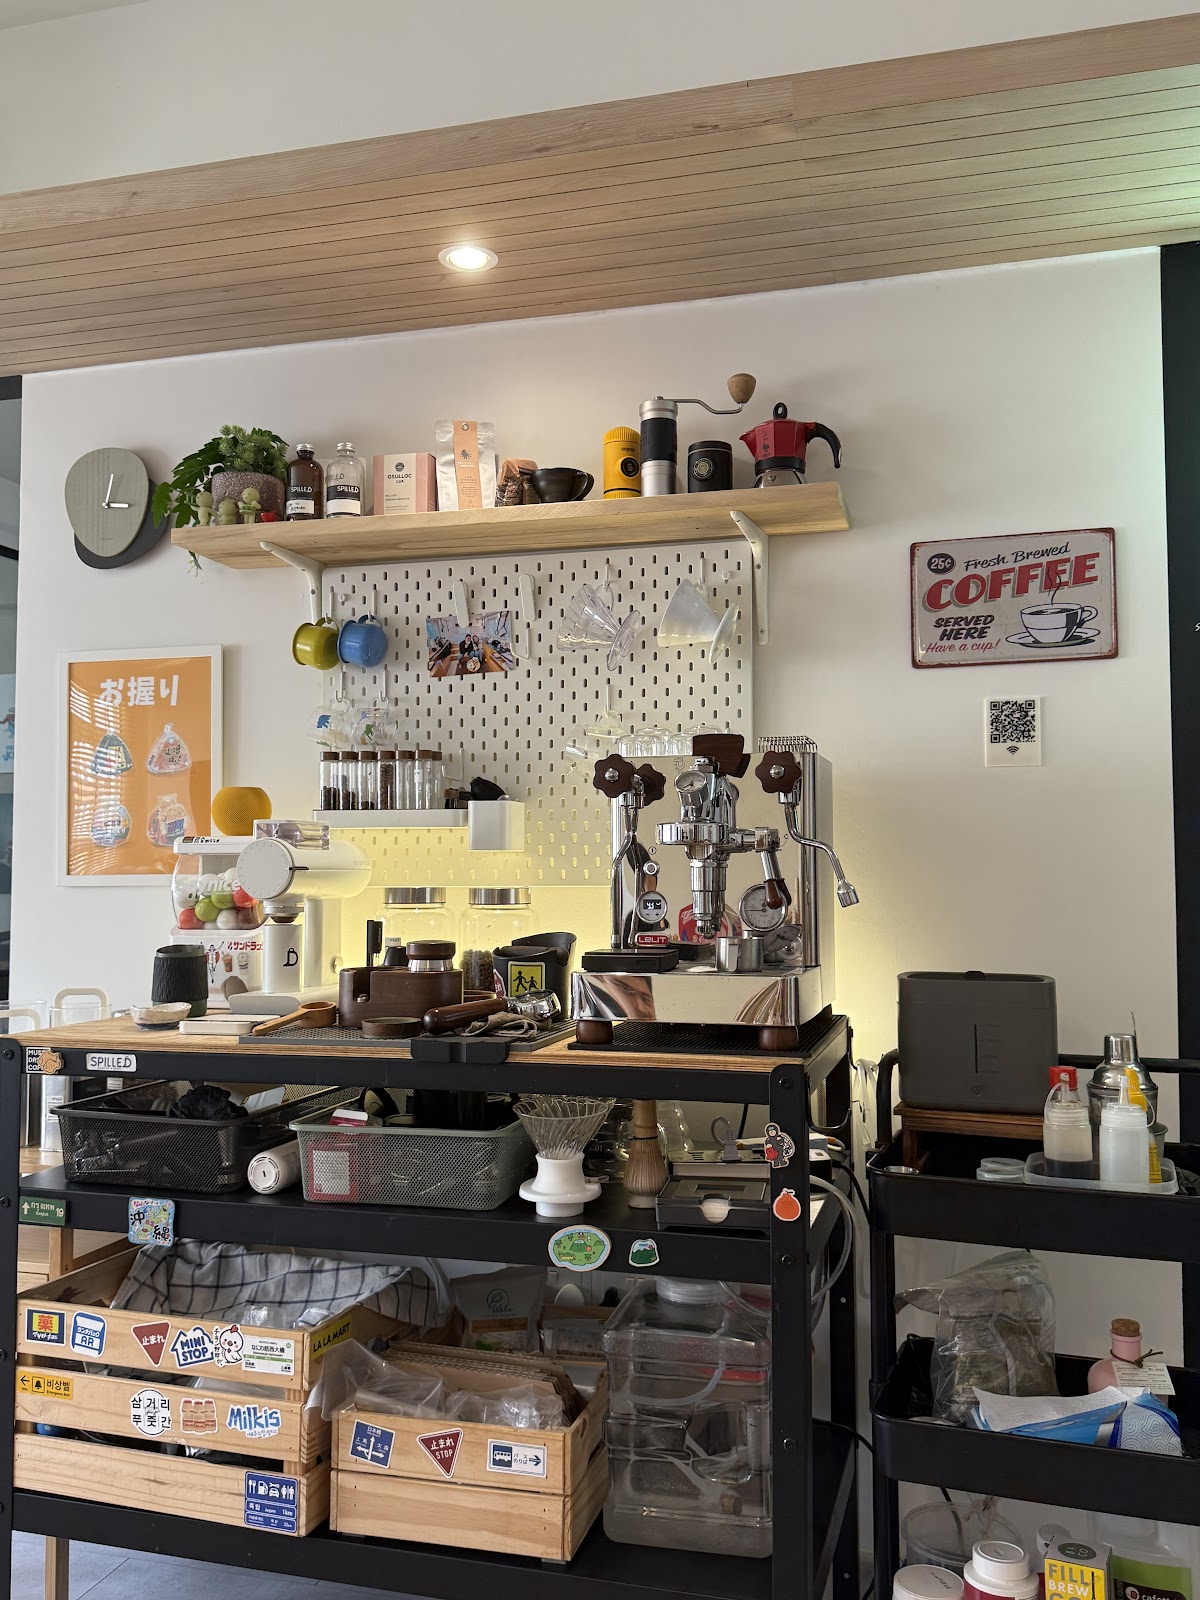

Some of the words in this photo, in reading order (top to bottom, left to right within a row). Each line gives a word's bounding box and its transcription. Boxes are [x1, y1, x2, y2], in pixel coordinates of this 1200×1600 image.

[337, 485, 359, 493] SPILLED
[964, 554, 1009, 572] Fresh
[1011, 541, 1071, 564] Brewed
[922, 552, 1100, 613] COFFEE
[933, 614, 995, 629] SERVED
[939, 626, 991, 642] HERE
[926, 642, 956, 654] Have
[958, 643, 969, 652] a
[971, 638, 1001, 654] cup!
[99, 674, 180, 707] お握り
[233, 941, 264, 951] サンドラッ
[638, 936, 667, 944] LELIT
[90, 1056, 132, 1068] SPILLED
[56, 1207, 64, 1218] 19
[38, 1314, 53, 1332] 薬
[141, 1333, 166, 1347] 止まれ
[180, 1335, 206, 1350] MINI
[313, 1341, 322, 1353] LA
[322, 1336, 332, 1348] LA
[332, 1322, 351, 1342] MART
[181, 1347, 209, 1362] STOP
[46, 1379, 70, 1392] 비상벨
[227, 1406, 281, 1431] Milkis
[430, 1436, 455, 1450] 止まれ
[435, 1449, 453, 1459] STOP
[1048, 1562, 1090, 1587] FILL
[1048, 1579, 1090, 1598] BREW
